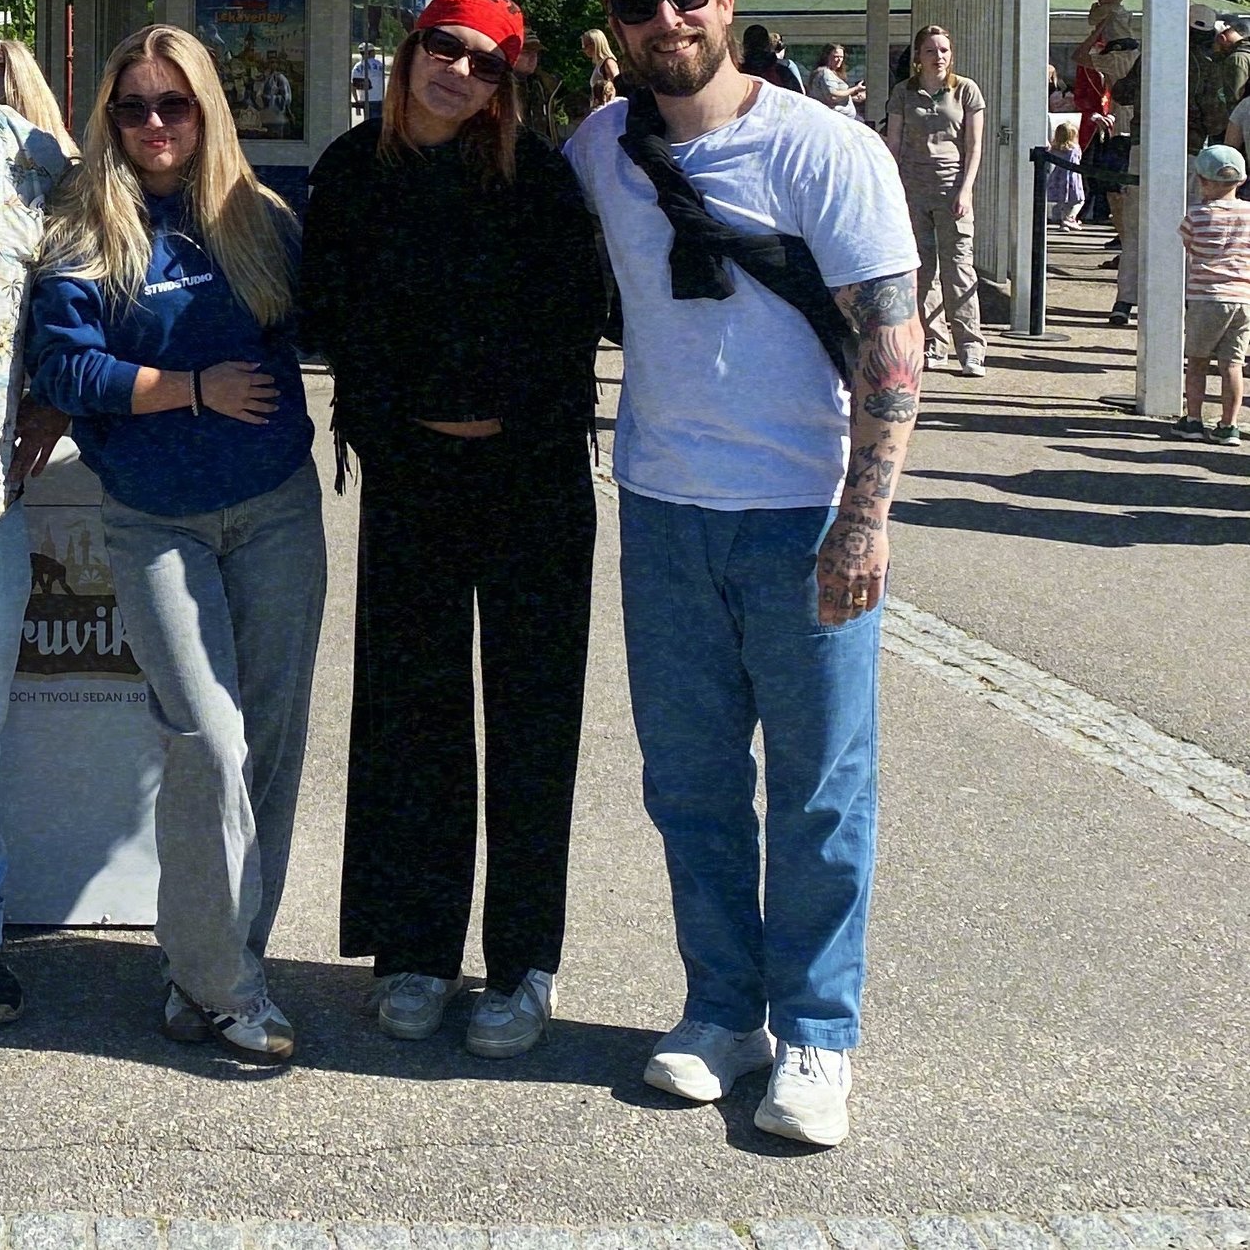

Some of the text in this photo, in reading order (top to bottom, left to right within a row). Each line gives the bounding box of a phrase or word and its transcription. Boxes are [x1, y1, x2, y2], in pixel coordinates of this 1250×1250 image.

[9, 692, 36, 703] OCH
[39, 692, 80, 703] TIVOLI
[83, 692, 123, 703] SEDAN
